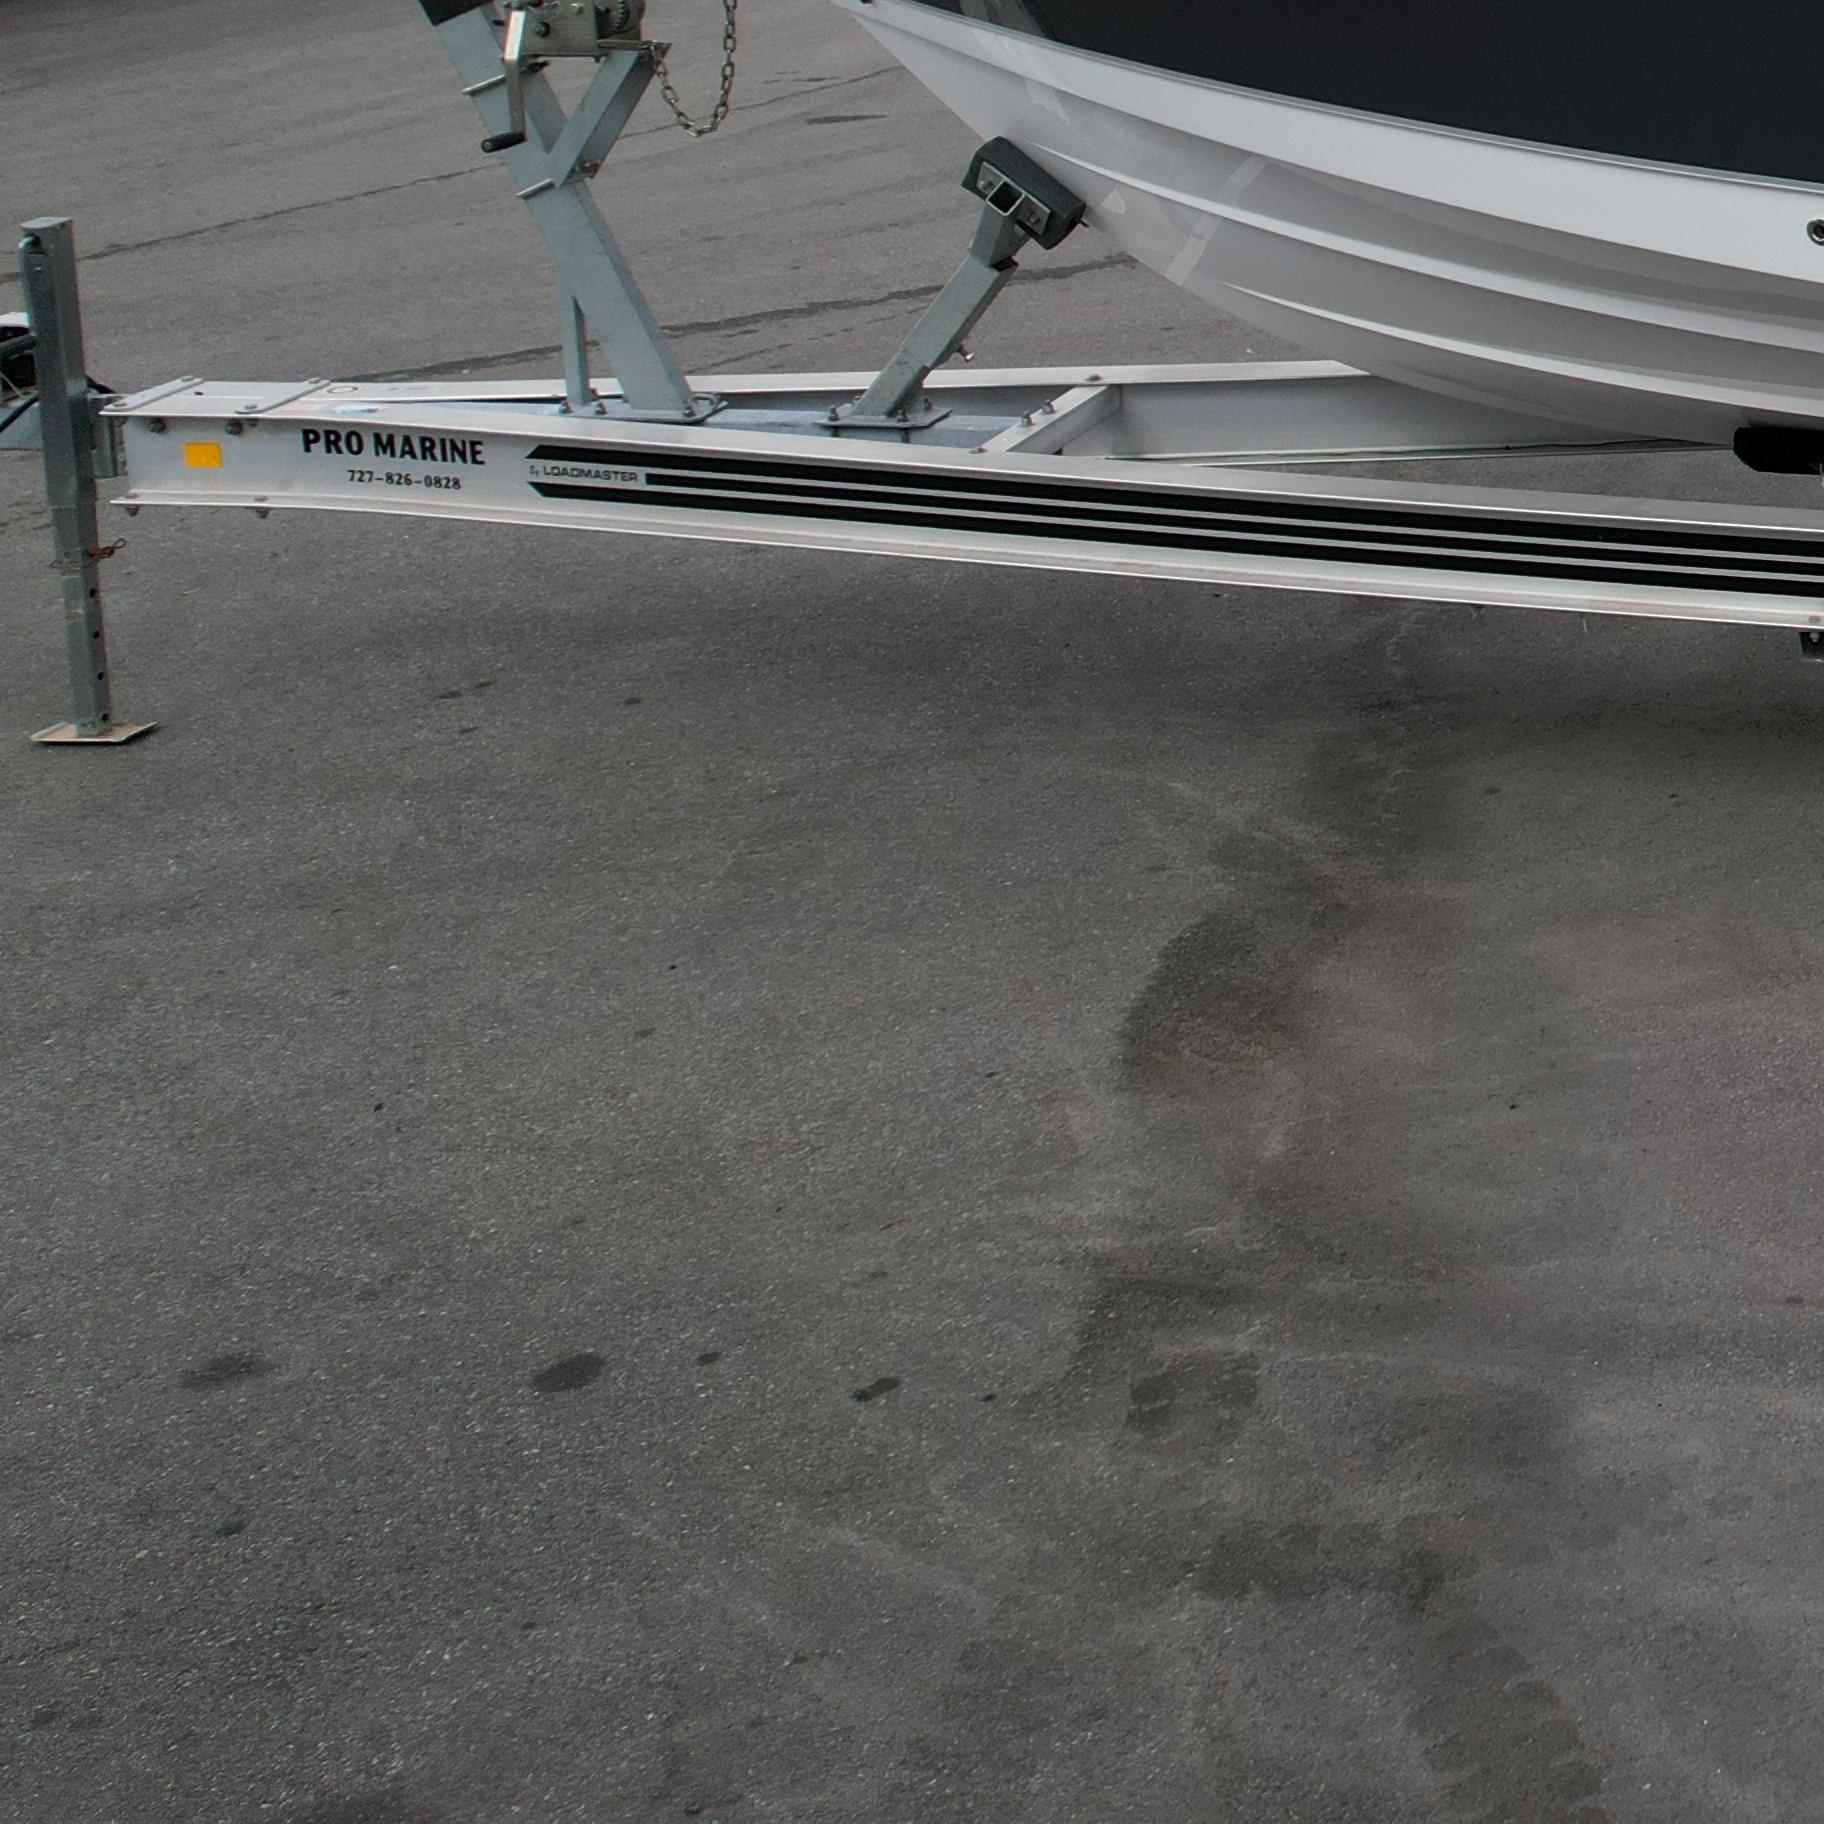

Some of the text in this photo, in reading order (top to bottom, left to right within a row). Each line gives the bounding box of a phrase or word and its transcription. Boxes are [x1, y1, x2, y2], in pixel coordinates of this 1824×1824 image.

[301, 428, 486, 466] PRO MARINE
[347, 469, 462, 491] 727-826-0828
[542, 465, 639, 482] LOADMASTER
